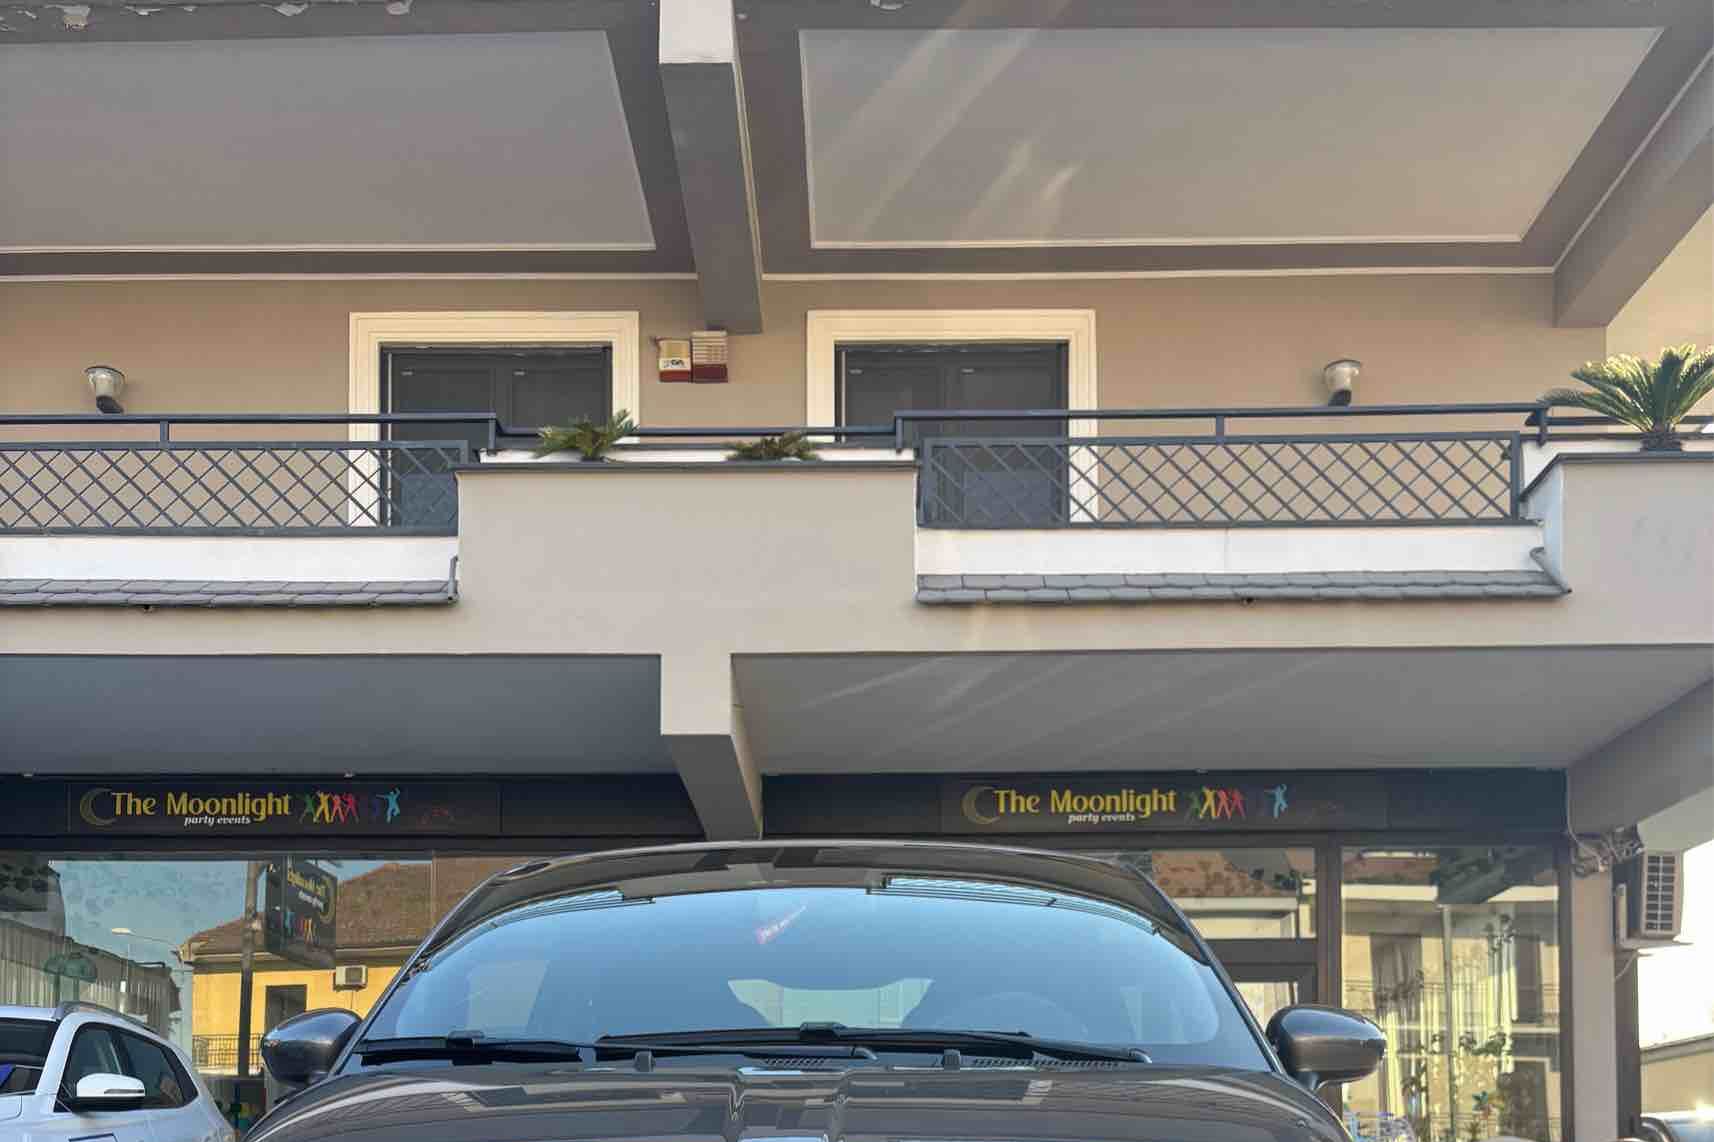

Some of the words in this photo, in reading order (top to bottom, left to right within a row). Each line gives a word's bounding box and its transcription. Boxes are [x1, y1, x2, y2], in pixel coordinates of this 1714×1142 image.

[112, 792, 156, 816] The
[167, 792, 290, 821] Moonlight
[994, 789, 1040, 813] The
[1051, 789, 1176, 817] Moonlight
[184, 816, 214, 827] party
[216, 816, 250, 825] events
[1068, 813, 1099, 824] party
[1102, 813, 1135, 822] events
